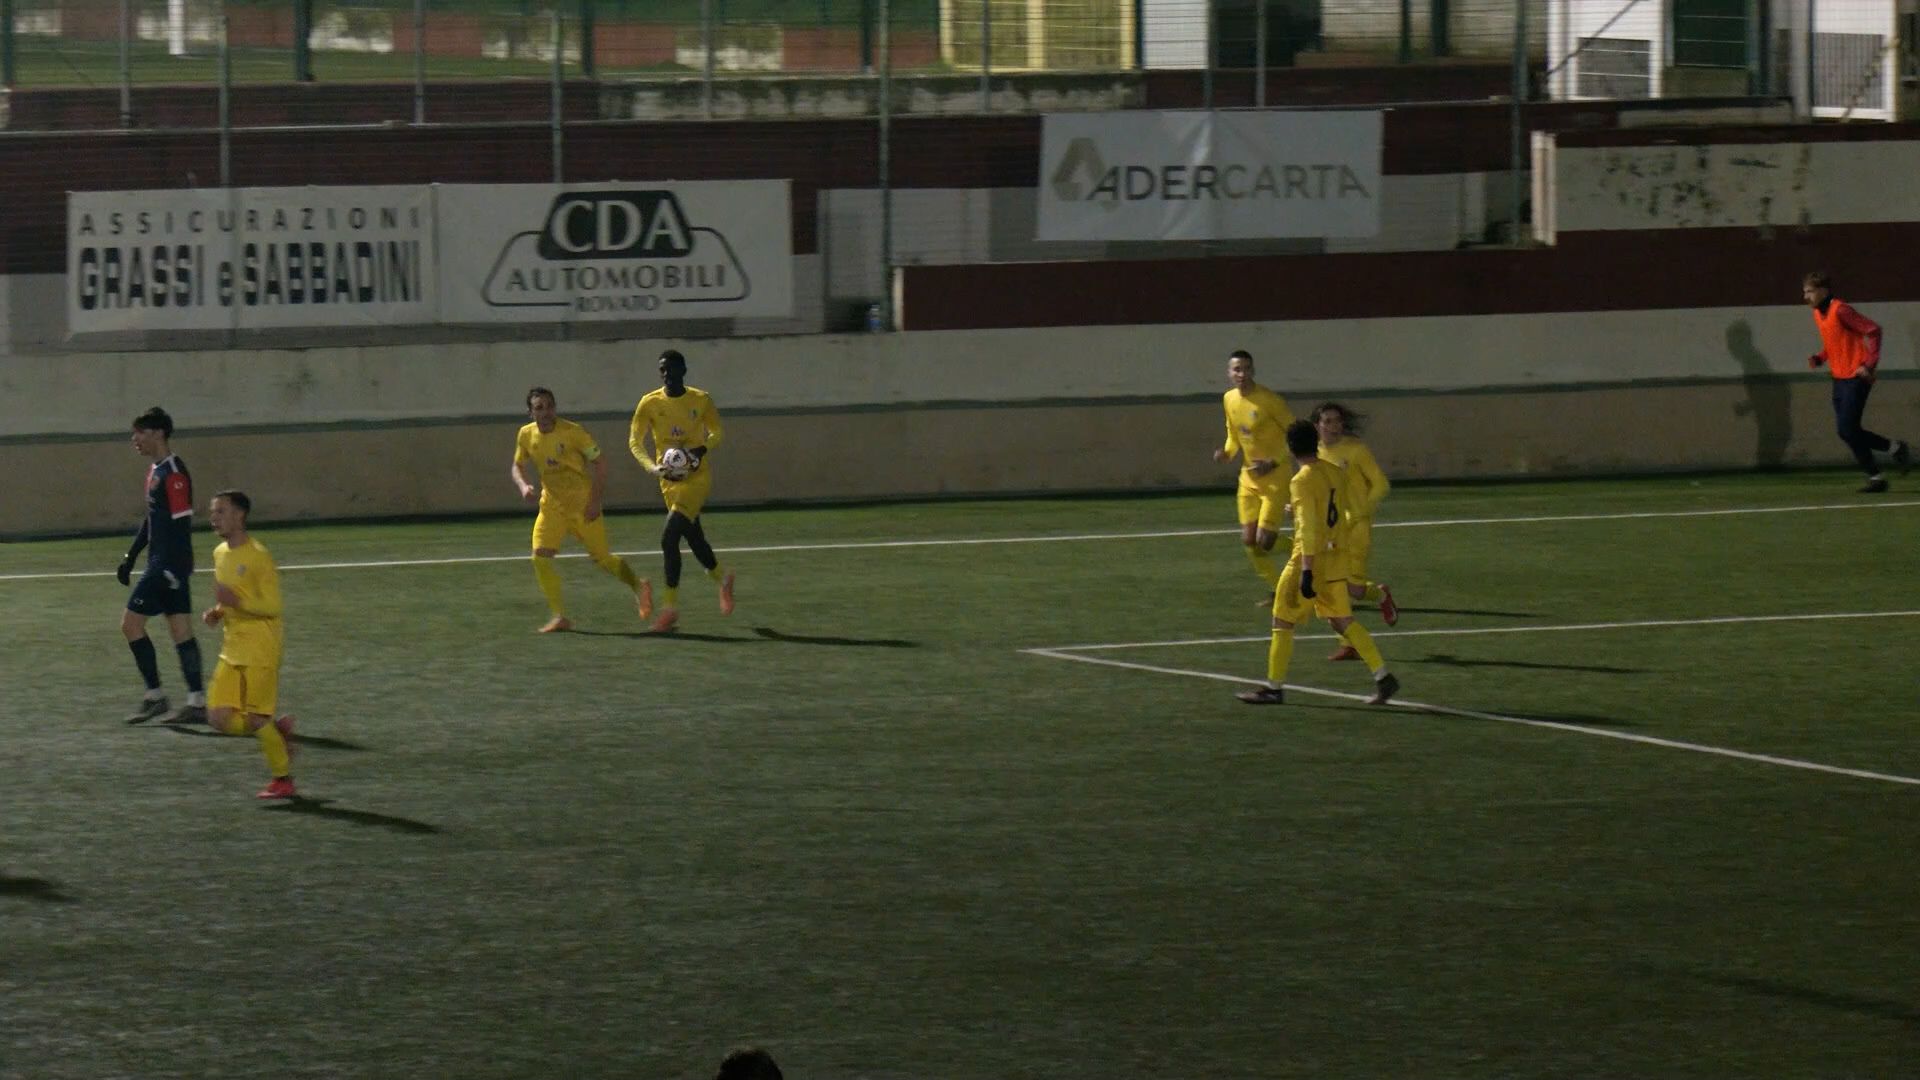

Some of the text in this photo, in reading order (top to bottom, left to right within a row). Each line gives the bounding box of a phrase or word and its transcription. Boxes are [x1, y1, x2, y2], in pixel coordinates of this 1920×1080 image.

[1087, 164, 1373, 201] ADERCARTA
[78, 207, 420, 236] ASSICURAZIONI
[550, 199, 690, 252] CDA
[79, 244, 204, 310] GRASSI
[244, 240, 421, 306] SABBADINI
[505, 264, 727, 292] AUTOMOBILI
[1326, 487, 1339, 529] 6
